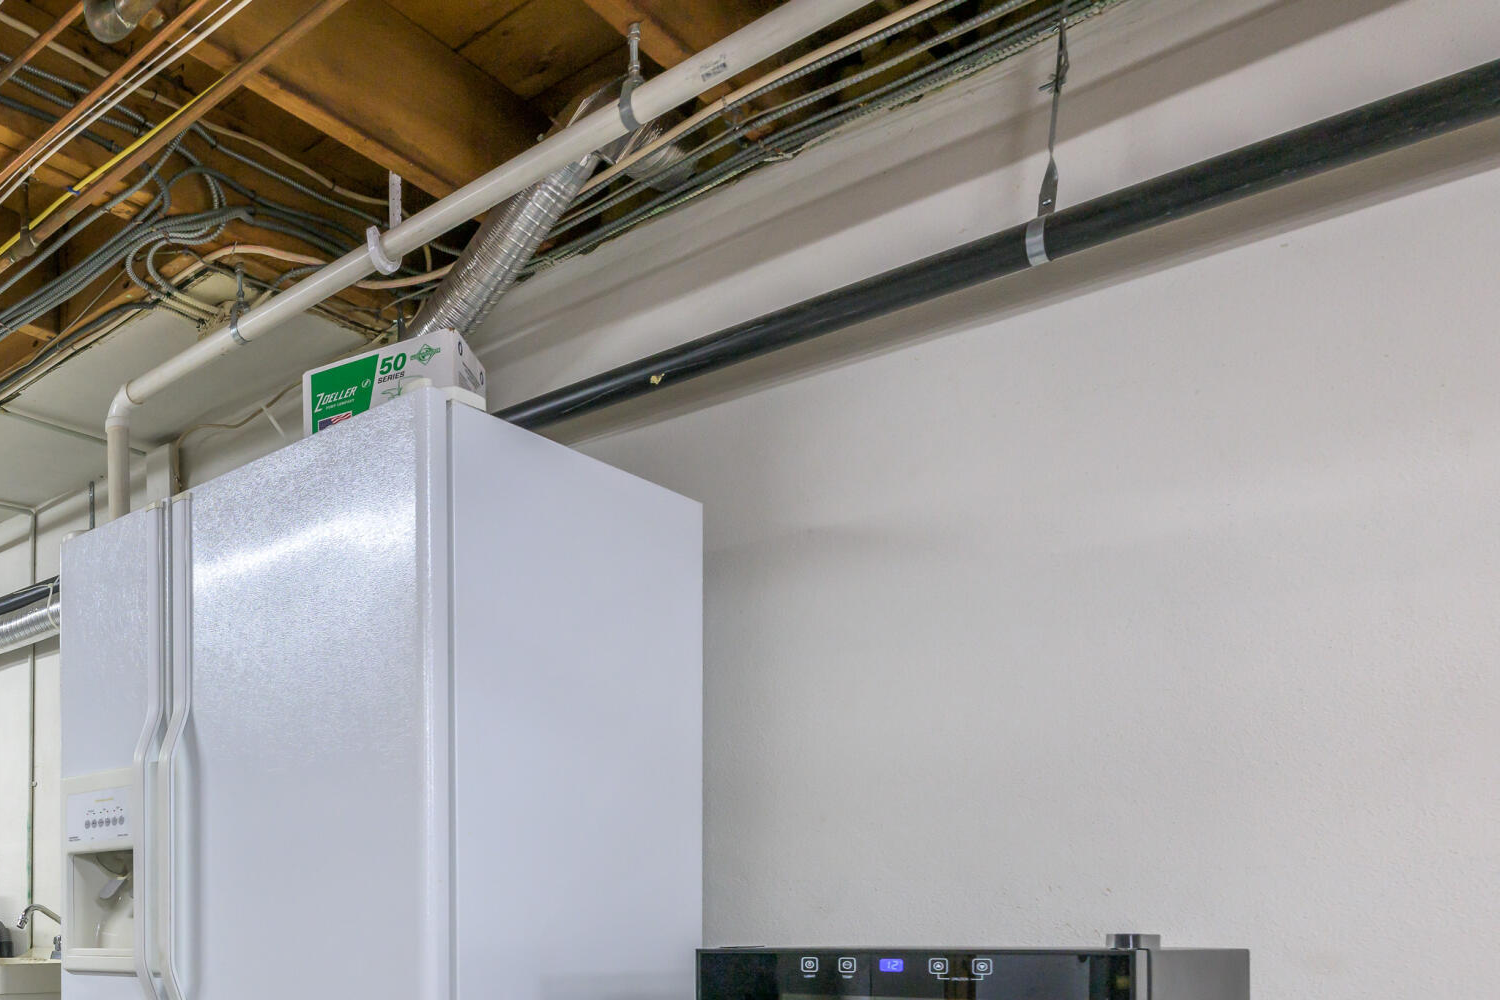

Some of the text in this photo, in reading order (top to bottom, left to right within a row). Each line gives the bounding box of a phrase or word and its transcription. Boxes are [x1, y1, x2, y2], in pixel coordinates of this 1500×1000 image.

[379, 352, 407, 375] 50
[377, 370, 405, 385] SERIES
[314, 385, 358, 413] ZOELLER
